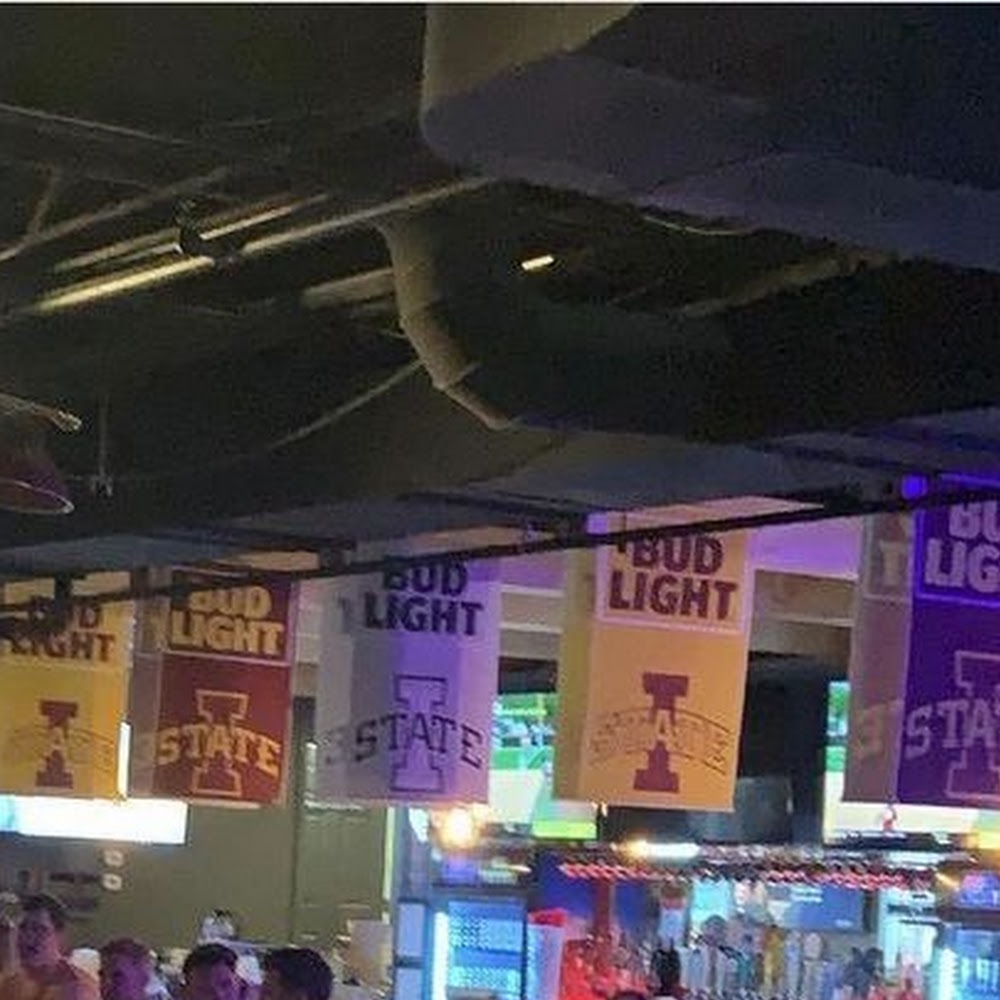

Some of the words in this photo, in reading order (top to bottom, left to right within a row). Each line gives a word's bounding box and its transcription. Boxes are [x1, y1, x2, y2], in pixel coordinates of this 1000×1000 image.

[949, 502, 1000, 541] BU
[384, 557, 467, 597] BUD
[632, 535, 724, 575] BUD
[925, 538, 1000, 593] LIG
[188, 585, 272, 619] BUD
[363, 592, 485, 637] LIGHT
[609, 570, 739, 621] LIGHT
[169, 609, 285, 656] LIGHT
[157, 724, 283, 777] STATE
[355, 712, 484, 770] STATE
[904, 700, 1000, 760] STA
